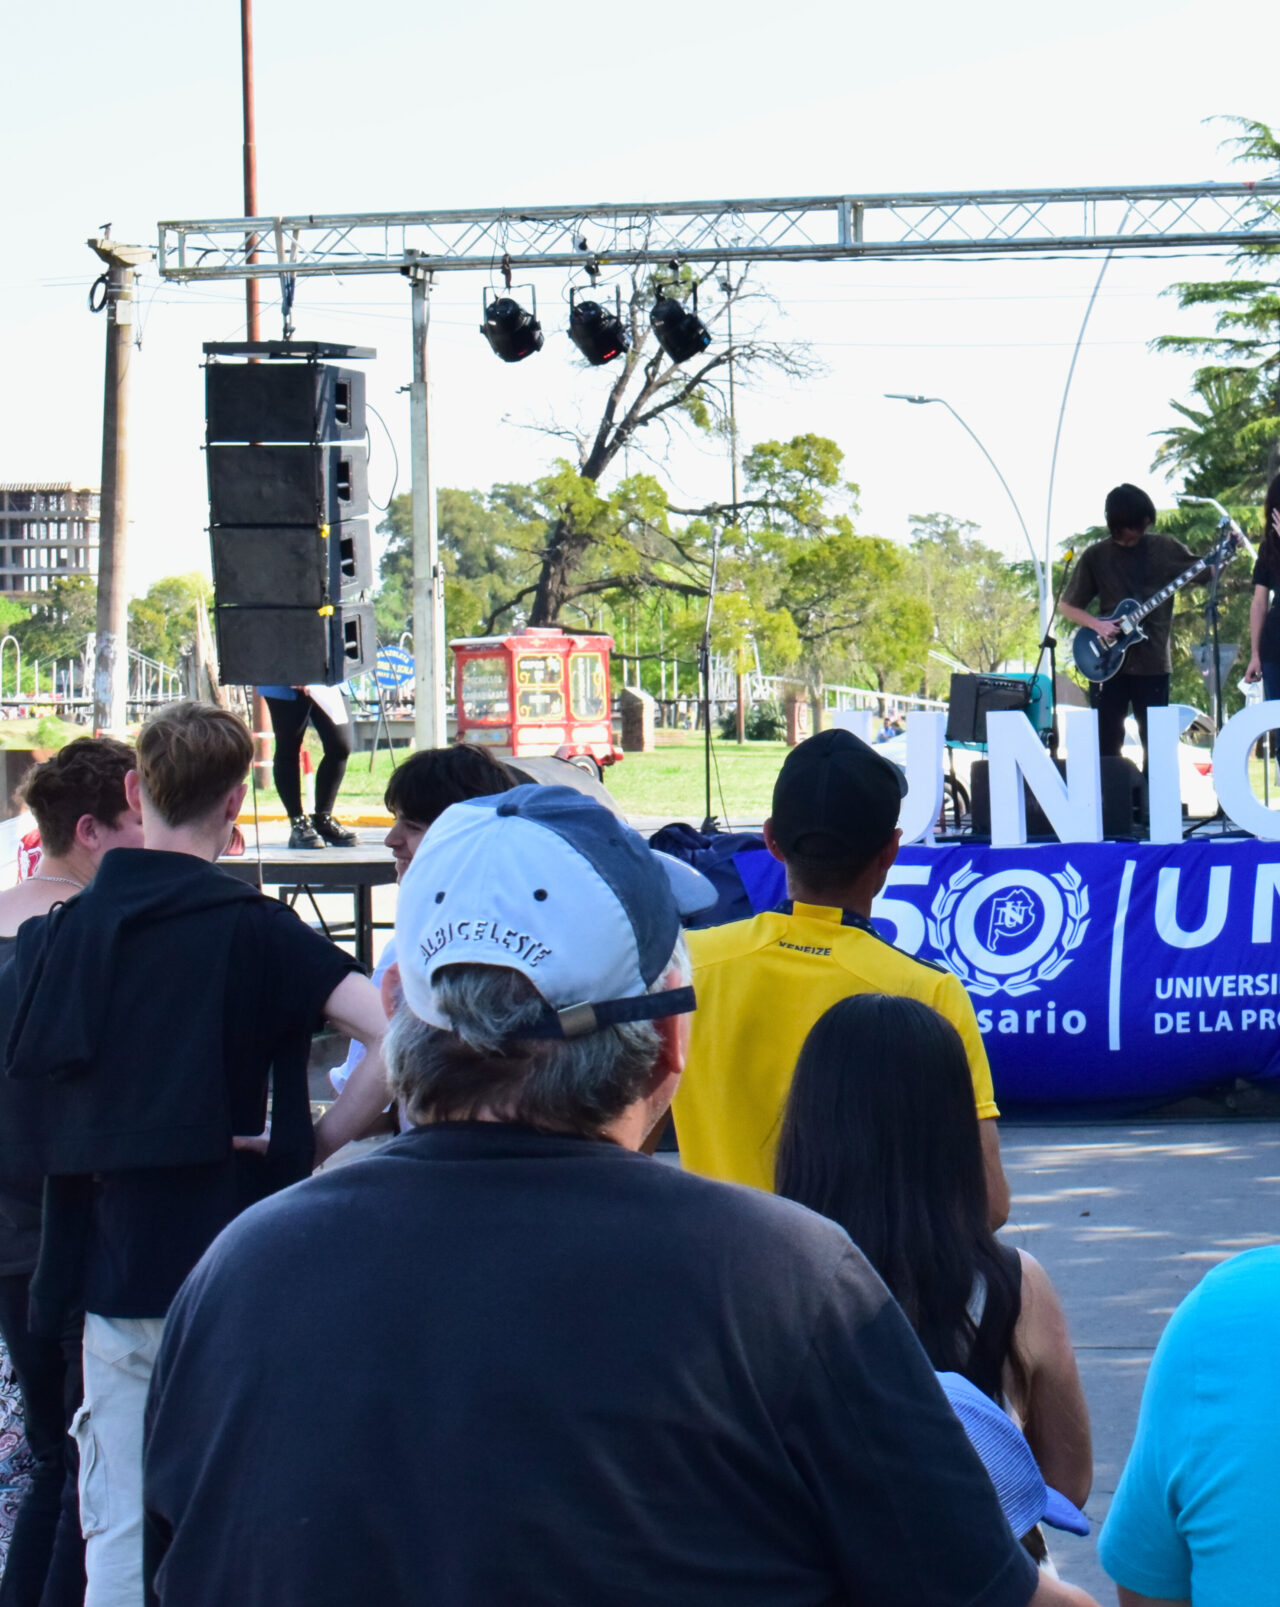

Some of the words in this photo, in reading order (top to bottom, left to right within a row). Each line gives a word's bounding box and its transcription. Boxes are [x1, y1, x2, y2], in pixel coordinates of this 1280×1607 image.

[420, 920, 552, 967] ALBICELESTE
[1154, 1012, 1190, 1034] DE
[1199, 1010, 1233, 1033] LA
